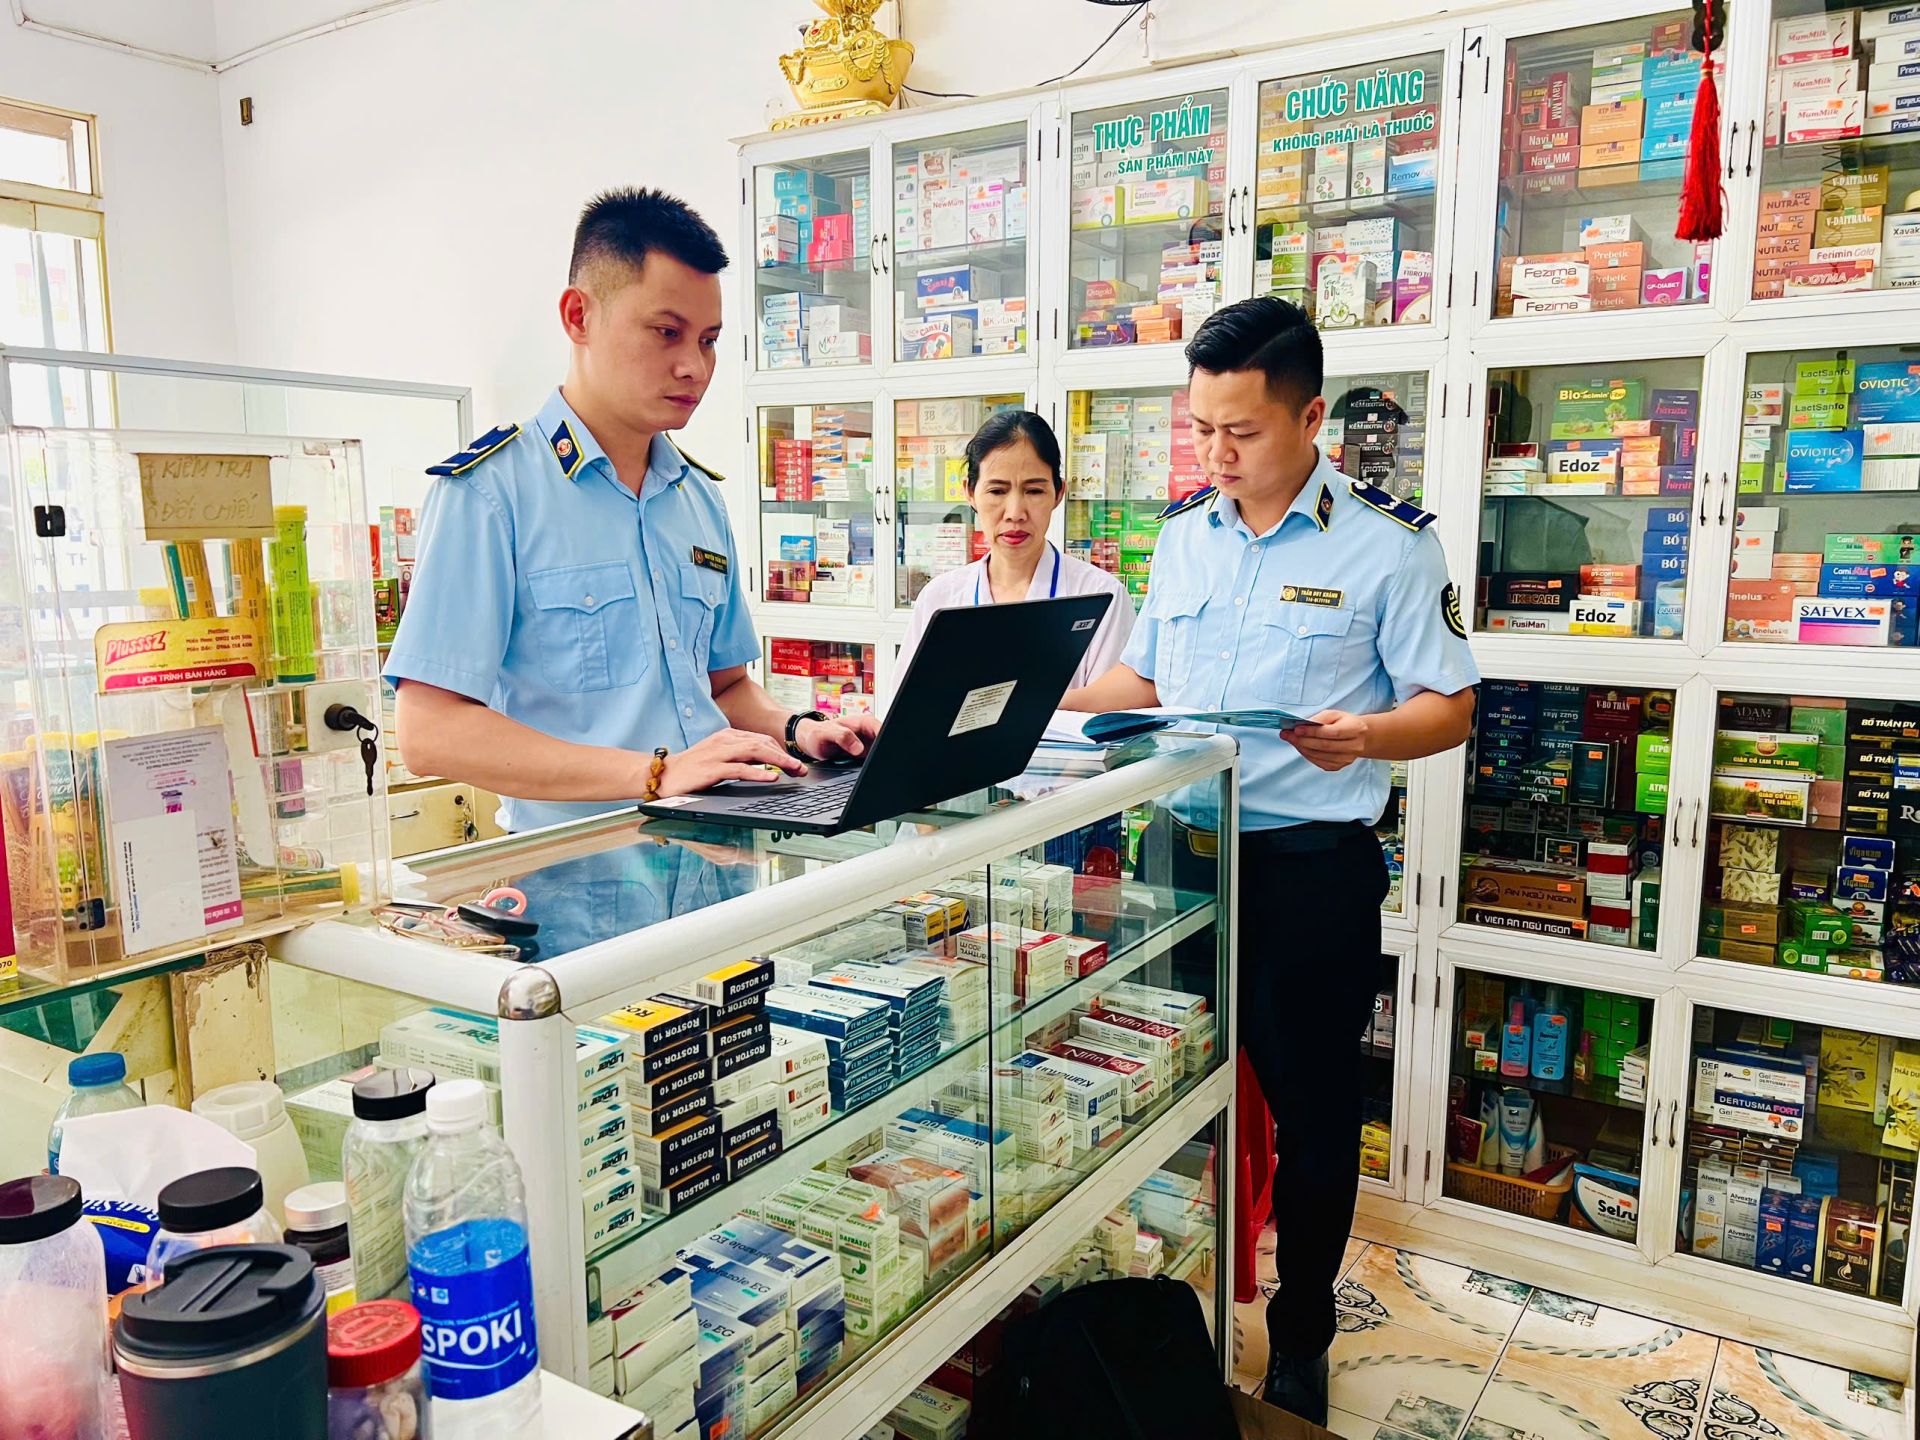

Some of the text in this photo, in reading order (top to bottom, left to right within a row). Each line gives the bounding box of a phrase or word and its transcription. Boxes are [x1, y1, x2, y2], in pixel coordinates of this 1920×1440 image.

[1788, 29, 1828, 42] MumMilk
[1793, 77, 1833, 89] MumMilk
[1286, 67, 1425, 122] CHỨC NĂNG
[1797, 108, 1840, 120] MumMilk
[1093, 94, 1212, 154] THỰC PHẨM
[1273, 110, 1435, 153] KHÔNG PHẢI LÀ THUỐC
[1529, 134, 1550, 146] Navi
[1146, 148, 1183, 171] PHẨM
[1187, 147, 1215, 166] NÀY
[1531, 152, 1571, 167] Navi MM
[1766, 199, 1811, 210] NUTRA-C
[1760, 221, 1803, 233] NUT-C
[1592, 249, 1630, 260] Prebetic
[1816, 247, 1876, 260] Ferimin Gold
[1524, 266, 1577, 279] Fezima
[1526, 300, 1579, 312] Fezima
[1801, 368, 1850, 379] LactSanfo
[1859, 377, 1910, 390] OVIOTIC
[1795, 402, 1845, 413] LactSanfo
[1790, 447, 1842, 458] OVIOTIC
[215, 460, 253, 479] TRA
[1559, 459, 1600, 473] Edoz
[1833, 568, 1852, 576] Cami
[1575, 608, 1616, 623] Edoz
[1800, 605, 1866, 618] SAFVEX
[1511, 619, 1547, 630] FusiMan
[1543, 924, 1571, 935] NGON
[761, 972, 769, 982] 10
[716, 1008, 726, 1018] 10
[433, 1022, 457, 1032] 10
[753, 1023, 764, 1034] 10
[652, 1033, 664, 1044] 10
[652, 1060, 663, 1071] 10
[724, 1058, 734, 1068] 10
[1065, 1048, 1137, 1071] Nifin 200
[584, 1068, 596, 1079] 10
[659, 1085, 670, 1097] 10
[577, 1102, 588, 1113] 10
[1718, 1107, 1733, 1116] Gel
[1719, 1095, 1800, 1116] DERTUSMA FORT
[660, 1112, 671, 1124] 10
[762, 1119, 772, 1131] 10
[583, 1135, 595, 1146] 10
[668, 1140, 680, 1152] 10
[768, 1142, 777, 1154] 10
[586, 1167, 598, 1179] 10
[669, 1164, 680, 1176] 10
[711, 1172, 721, 1185] 10
[593, 1200, 605, 1213] 10
[765, 1212, 797, 1227] DAFRAZOL
[594, 1228, 605, 1241] 10
[802, 1223, 834, 1239] DAFRAZOL
[708, 1233, 728, 1245] EG
[839, 1233, 872, 1249] DAFRAZOL
[750, 1281, 772, 1294] EG
[421, 1307, 523, 1358] SPOKI
[712, 1324, 736, 1338] EG
[909, 1390, 939, 1408] ebilax
